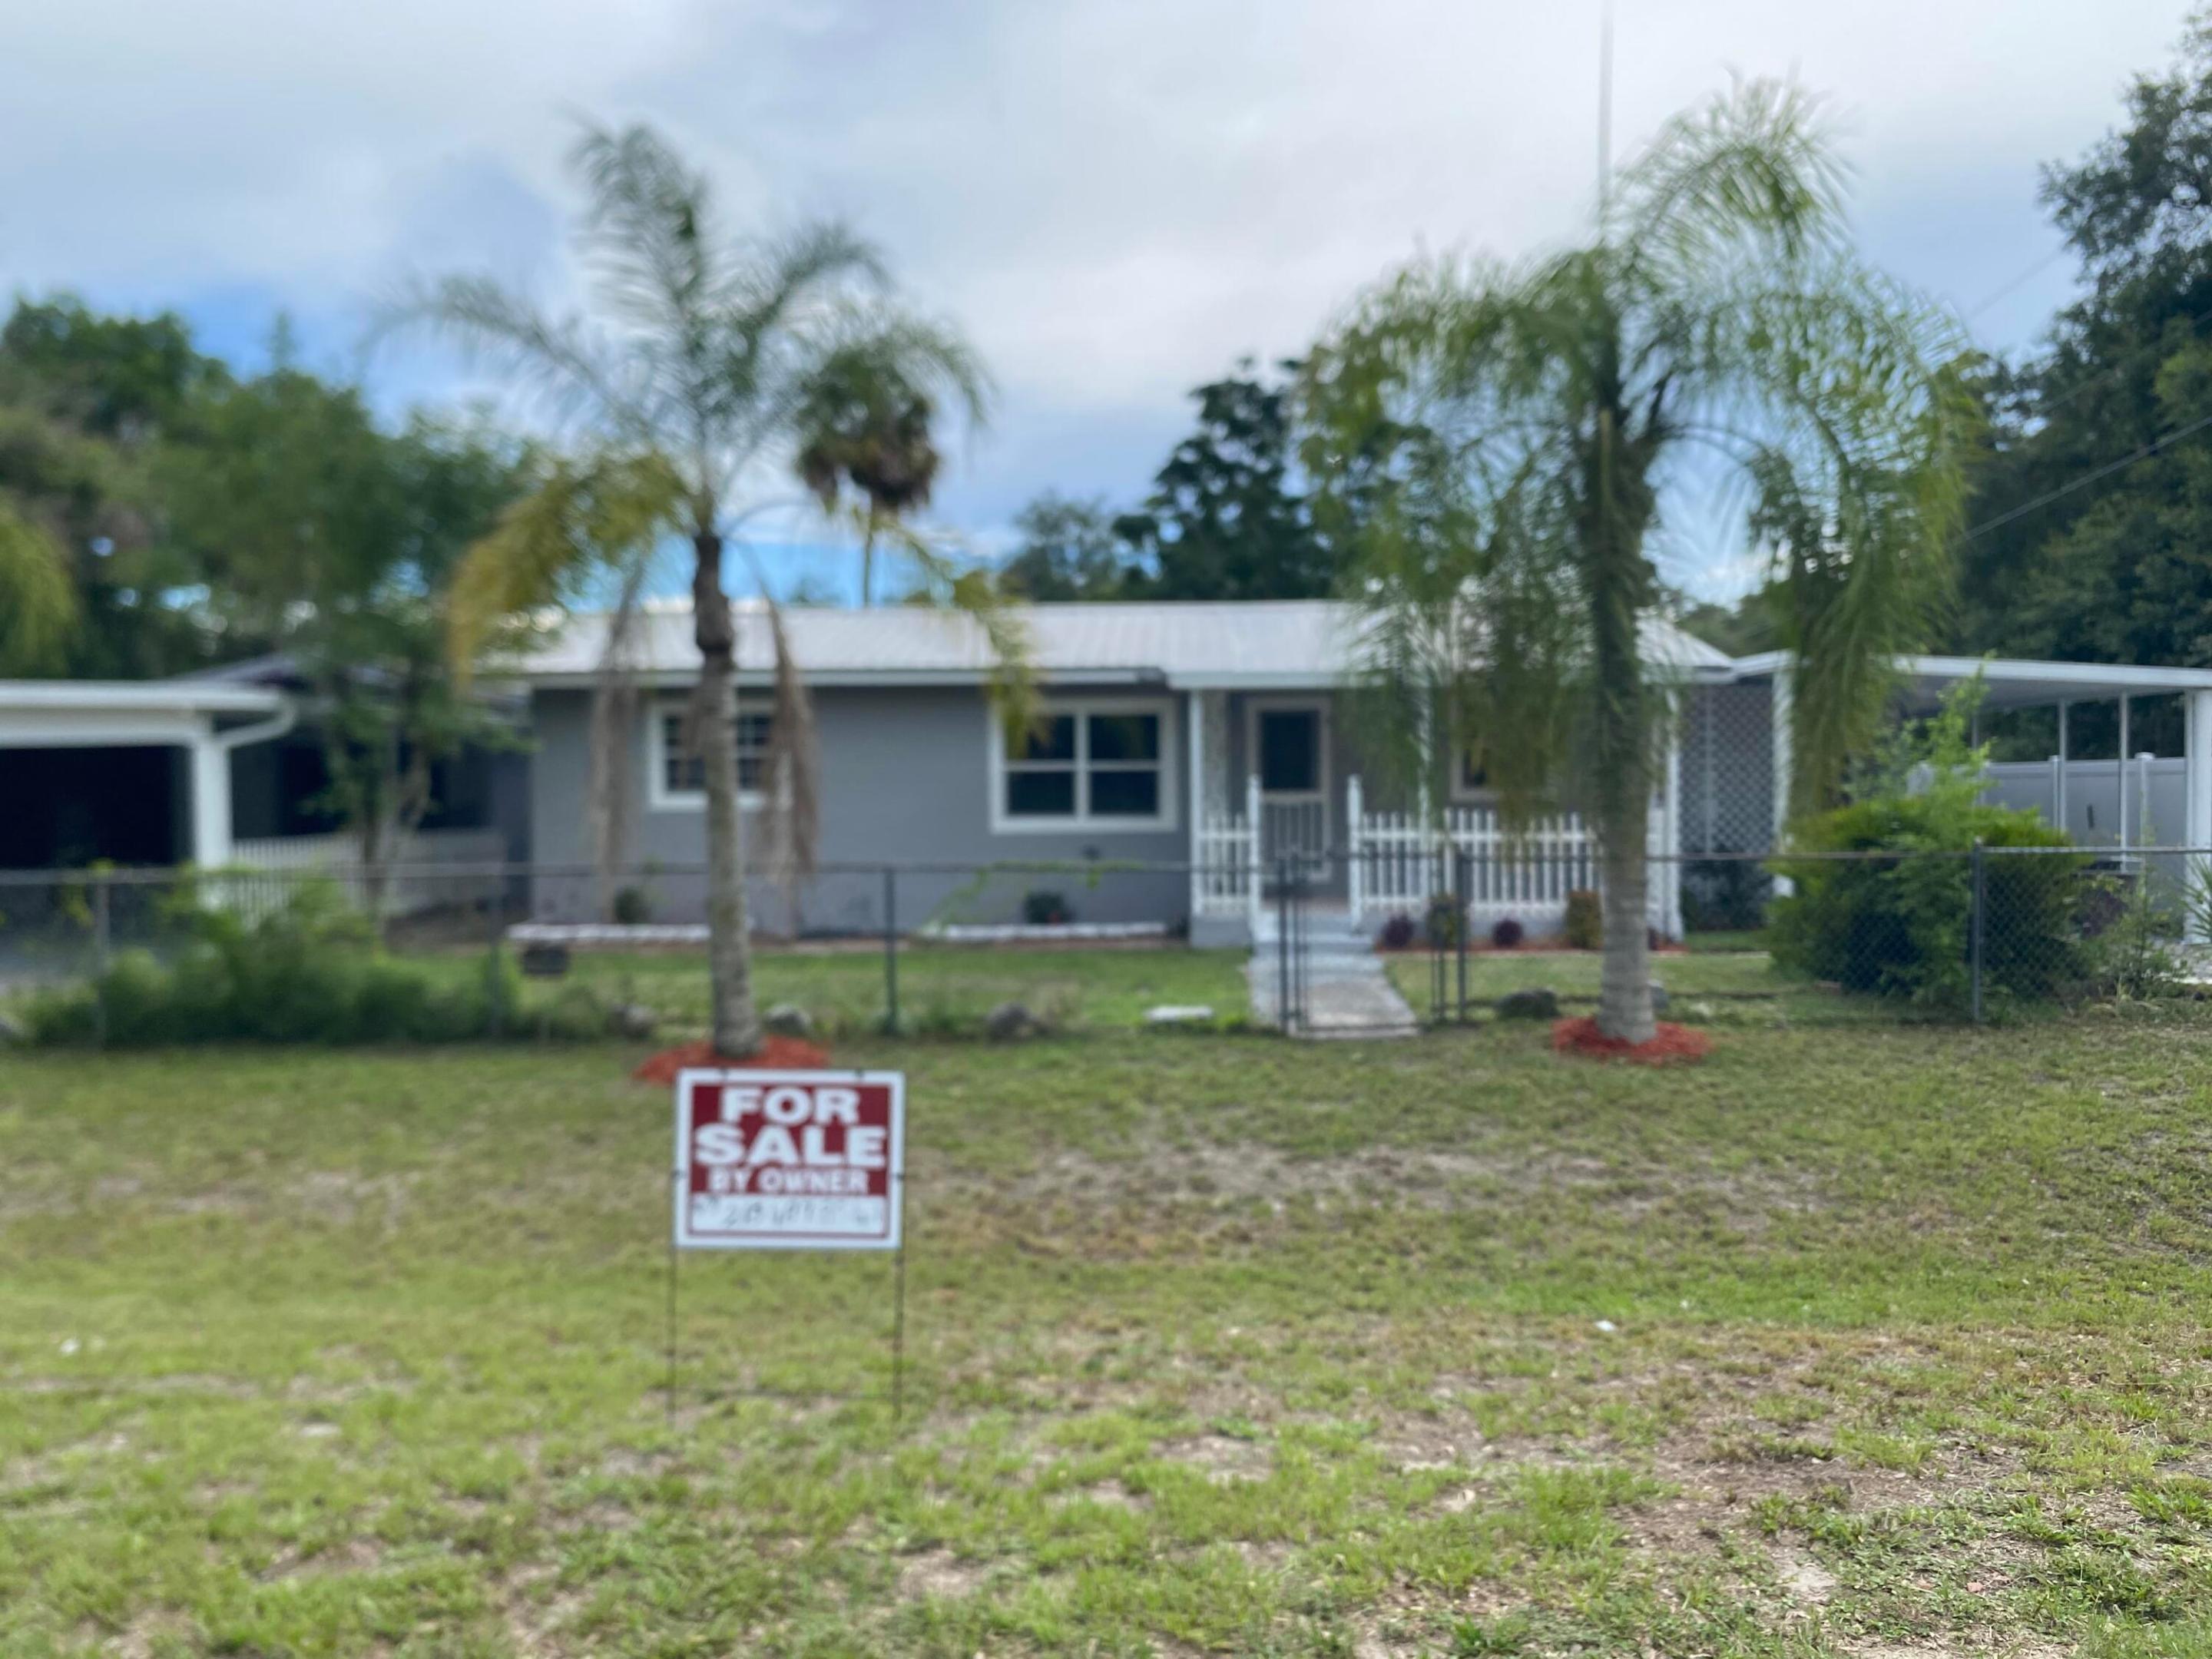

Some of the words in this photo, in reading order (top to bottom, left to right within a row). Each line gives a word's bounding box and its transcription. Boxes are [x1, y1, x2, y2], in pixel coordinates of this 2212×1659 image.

[721, 1088, 859, 1126] FOR
[694, 1124, 886, 1167] SALE
[708, 1168, 753, 1193] BY
[757, 1167, 869, 1195] OWNER
